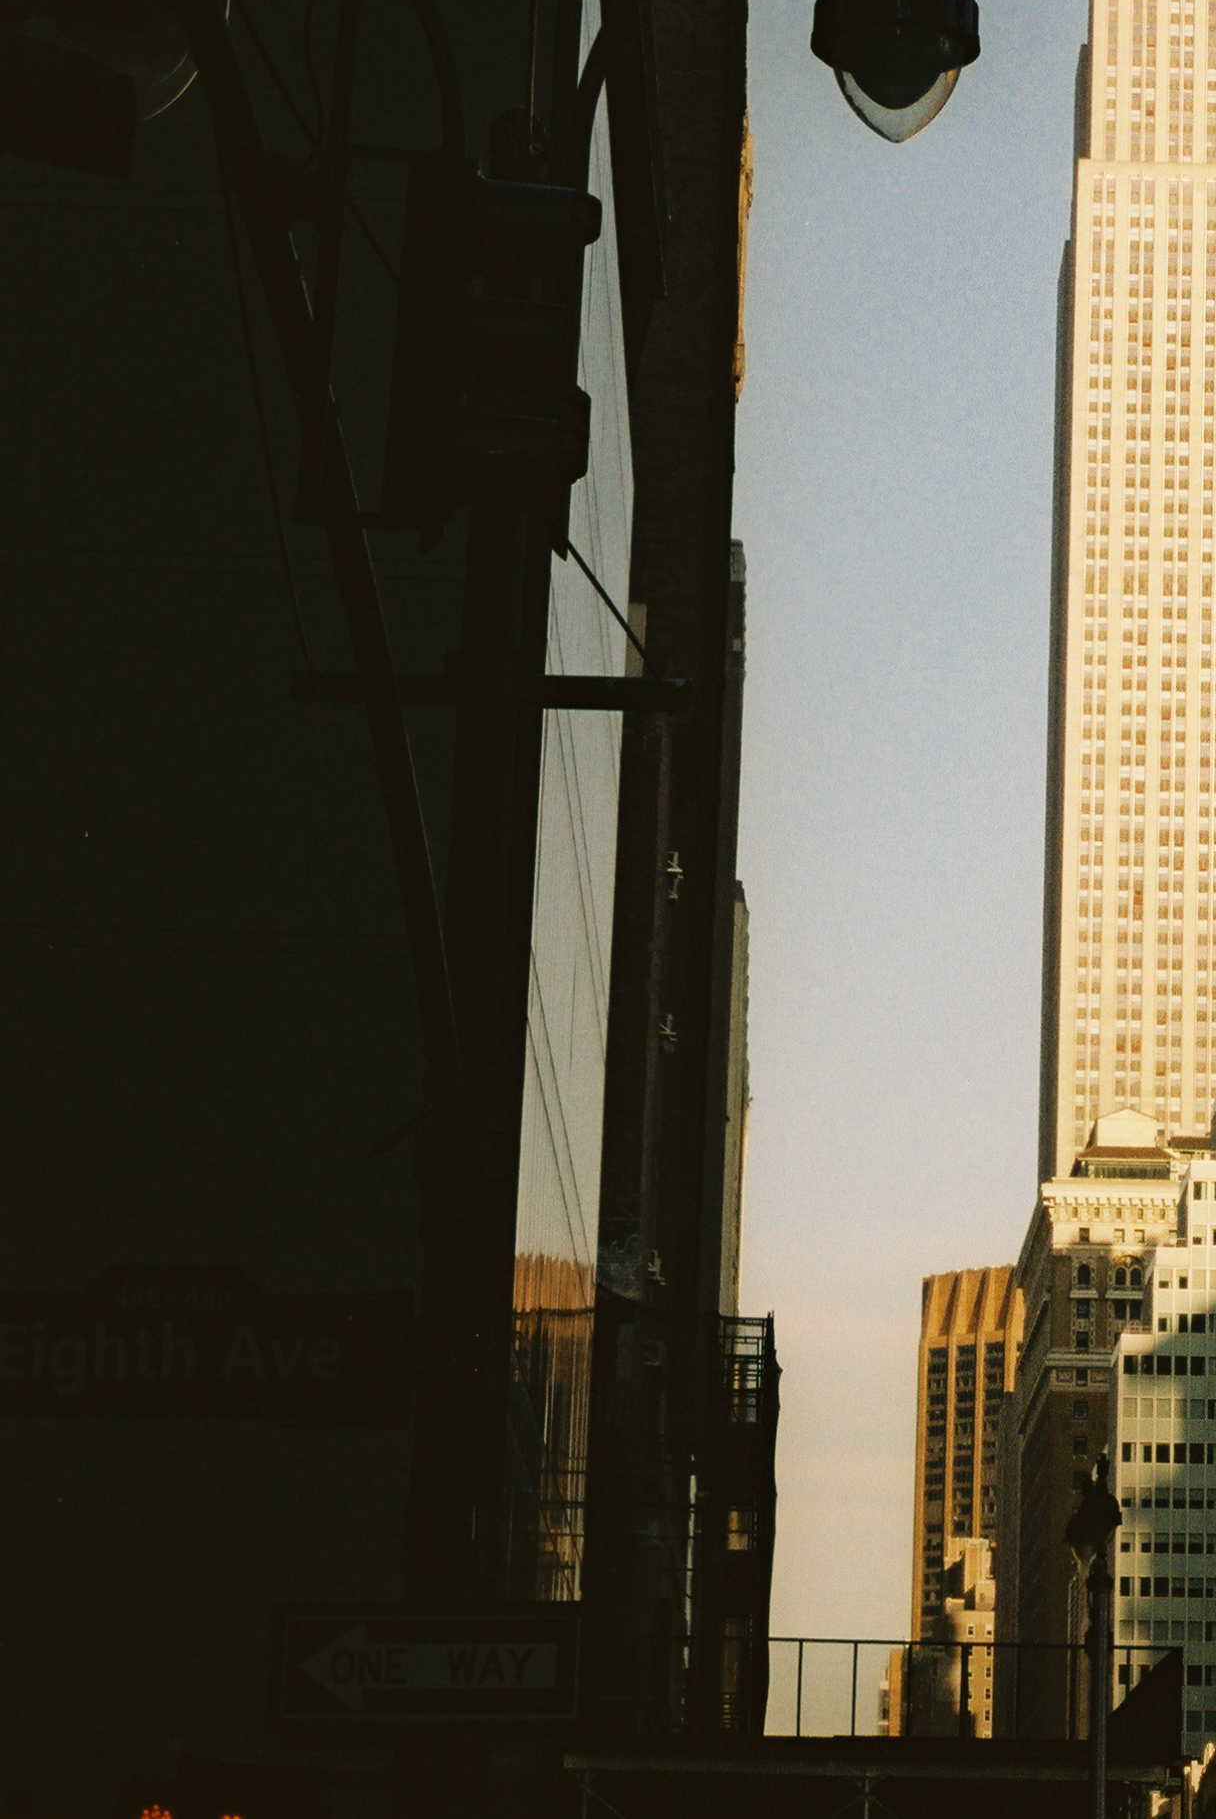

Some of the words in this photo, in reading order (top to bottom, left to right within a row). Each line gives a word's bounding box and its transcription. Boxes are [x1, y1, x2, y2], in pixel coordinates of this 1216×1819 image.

[0, 1321, 196, 1395] Eighth
[220, 1325, 343, 1381] Ave
[331, 1647, 407, 1685] ONE
[449, 1646, 534, 1685] WAY
